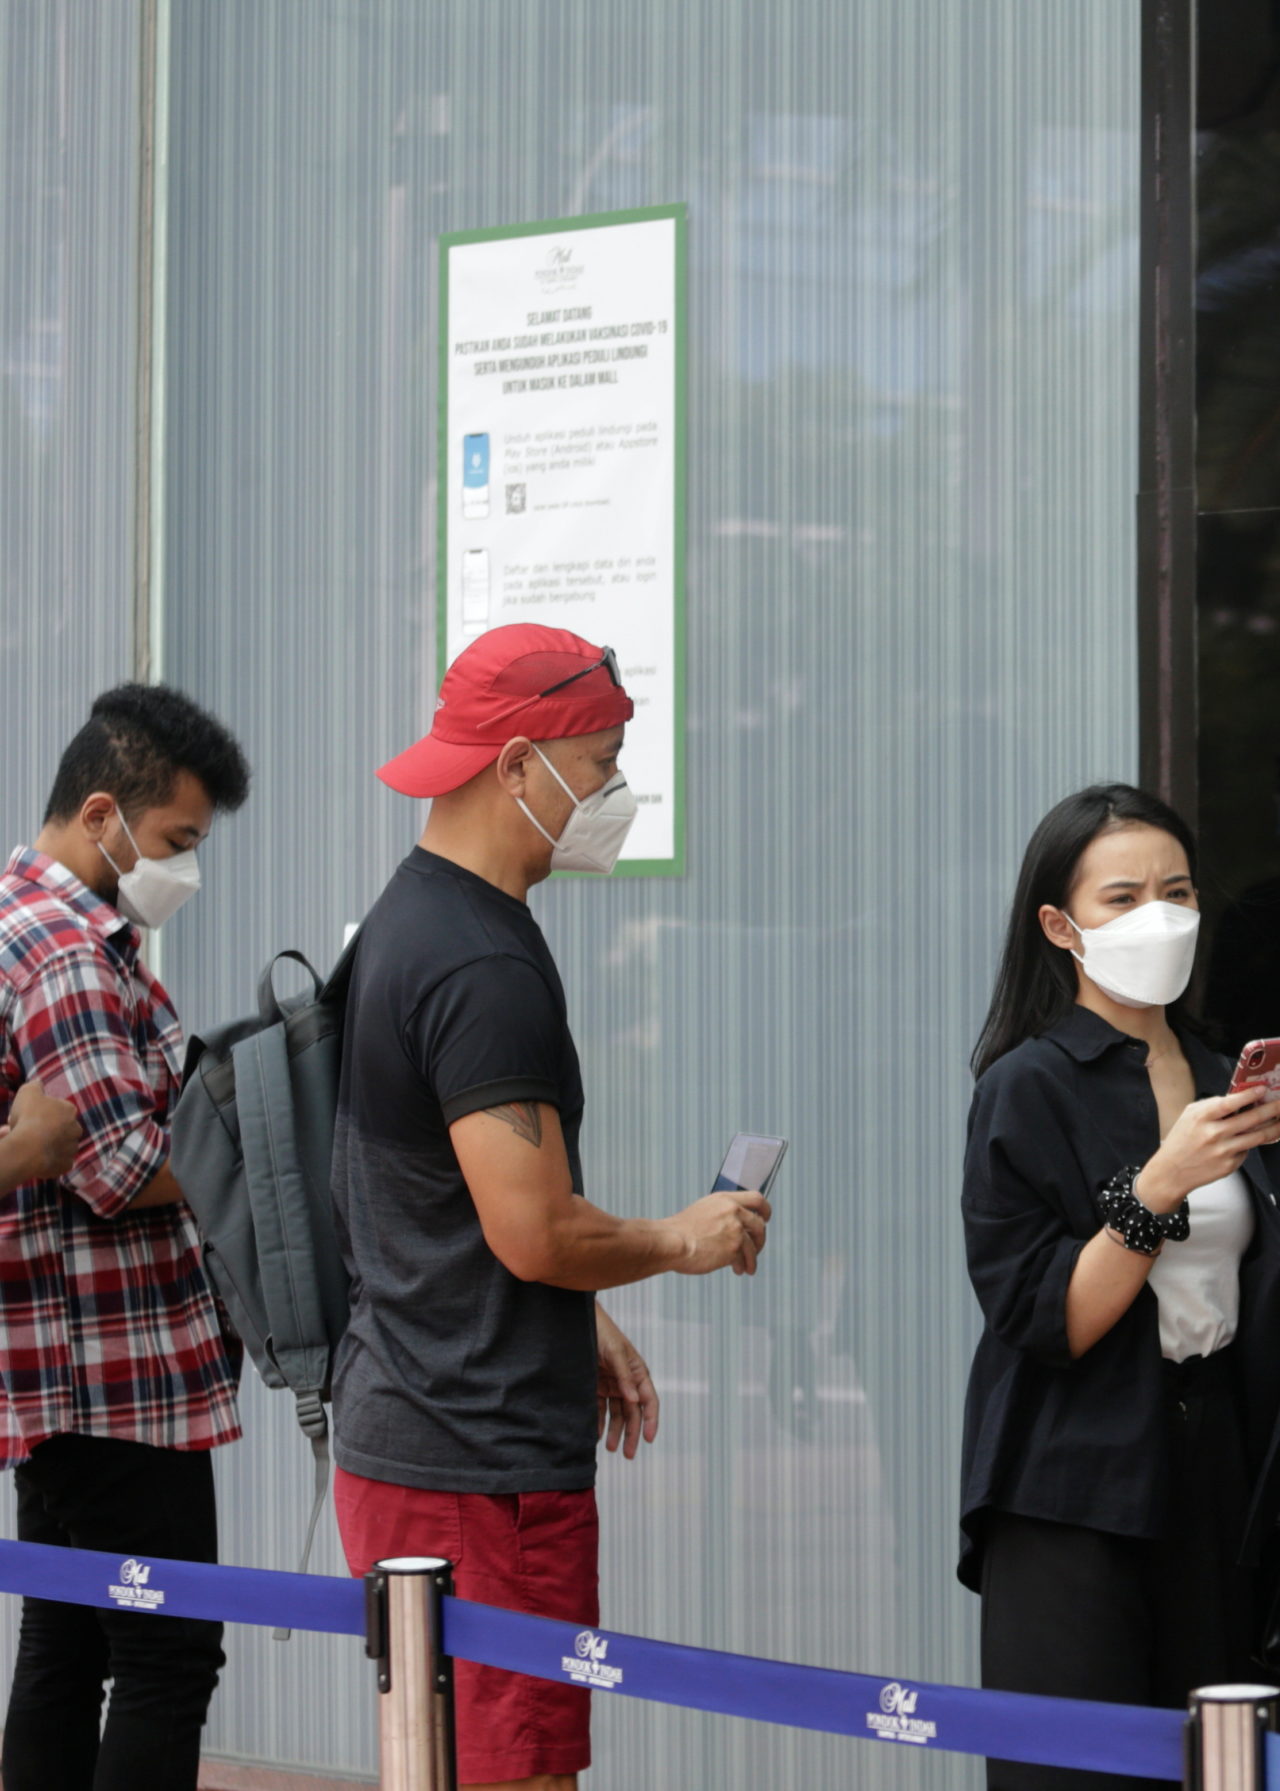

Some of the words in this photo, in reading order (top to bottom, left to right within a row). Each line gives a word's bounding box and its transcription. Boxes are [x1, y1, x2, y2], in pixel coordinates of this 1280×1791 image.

[527, 308, 561, 326] SELAMAT
[563, 306, 592, 325] DATANG
[455, 339, 490, 355] PASTIKAN
[491, 337, 511, 352] ANDA
[513, 334, 539, 350] SUDAH
[540, 331, 586, 347] MELAKUKAN
[589, 325, 629, 341] VAKSINASI
[474, 360, 497, 376] SERTA
[499, 355, 546, 373] MENGUNDUH
[547, 350, 581, 367] APLIKASI
[583, 347, 609, 364] PEDULI
[611, 344, 648, 361] LINDUNGI
[502, 377, 526, 395] UNTUK
[529, 375, 556, 391] MASUK
[557, 375, 567, 388] KE
[569, 371, 596, 388] DALAM
[597, 370, 618, 386] MALL
